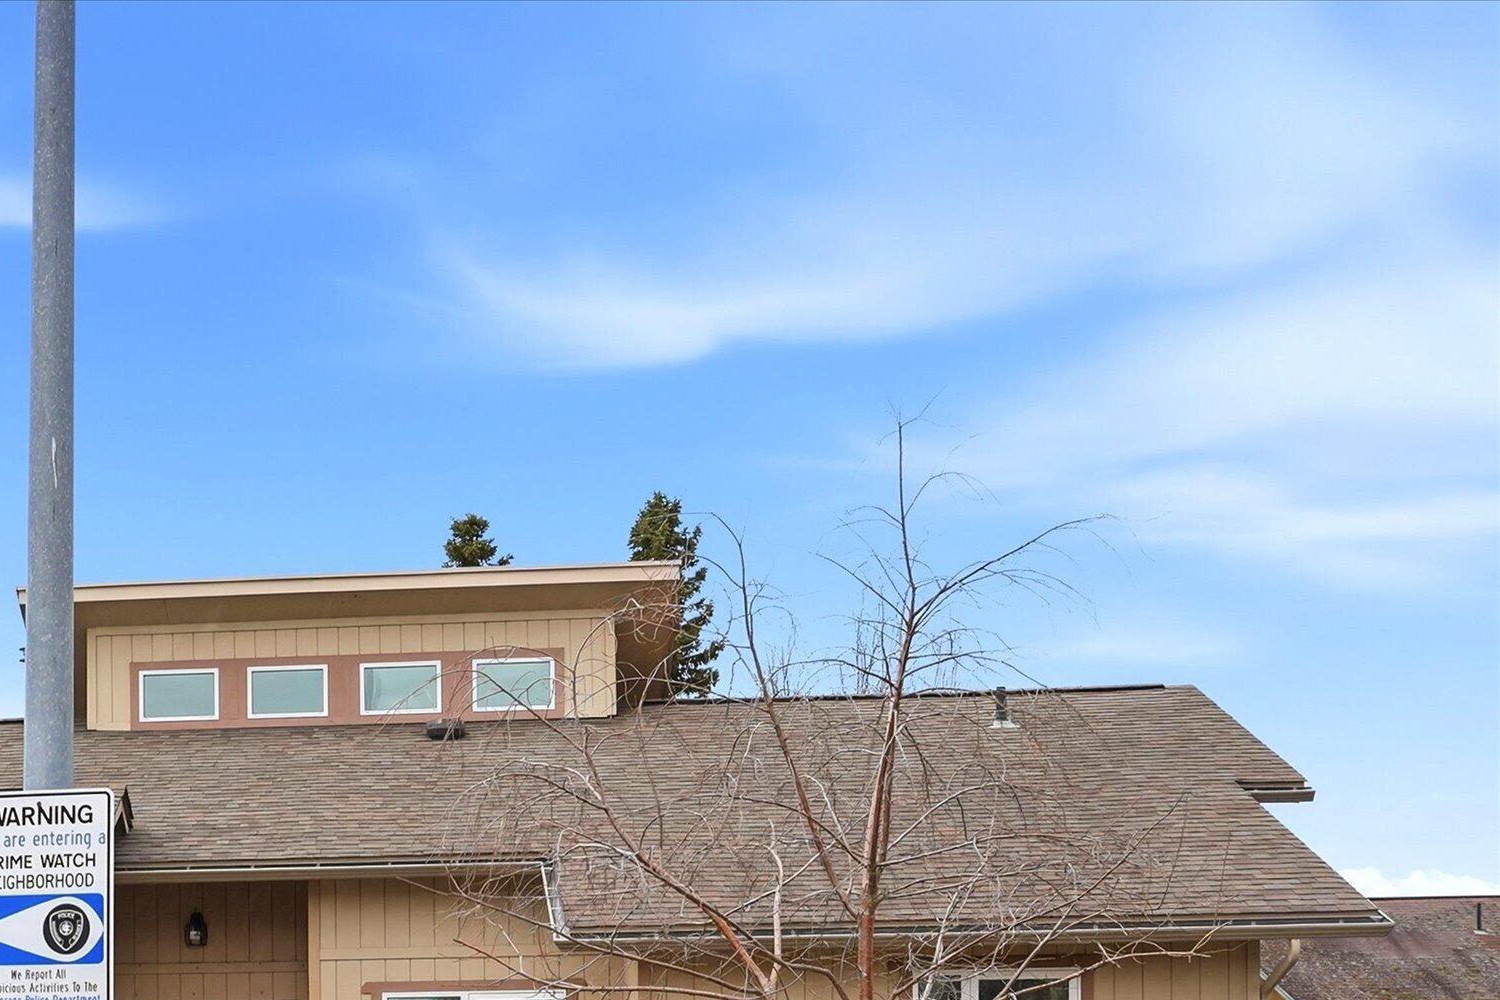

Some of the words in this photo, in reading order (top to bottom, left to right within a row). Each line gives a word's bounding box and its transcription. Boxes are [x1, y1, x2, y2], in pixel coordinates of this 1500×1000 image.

[3, 834, 26, 847] are
[32, 830, 92, 850] entering
[98, 832, 106, 845] a
[40, 853, 96, 868] WATCH
[10, 970, 22, 981] We
[25, 969, 52, 981] Report
[55, 969, 67, 979] All
[29, 982, 69, 994] Activities
[73, 981, 81, 992] To
[84, 981, 98, 992] The
